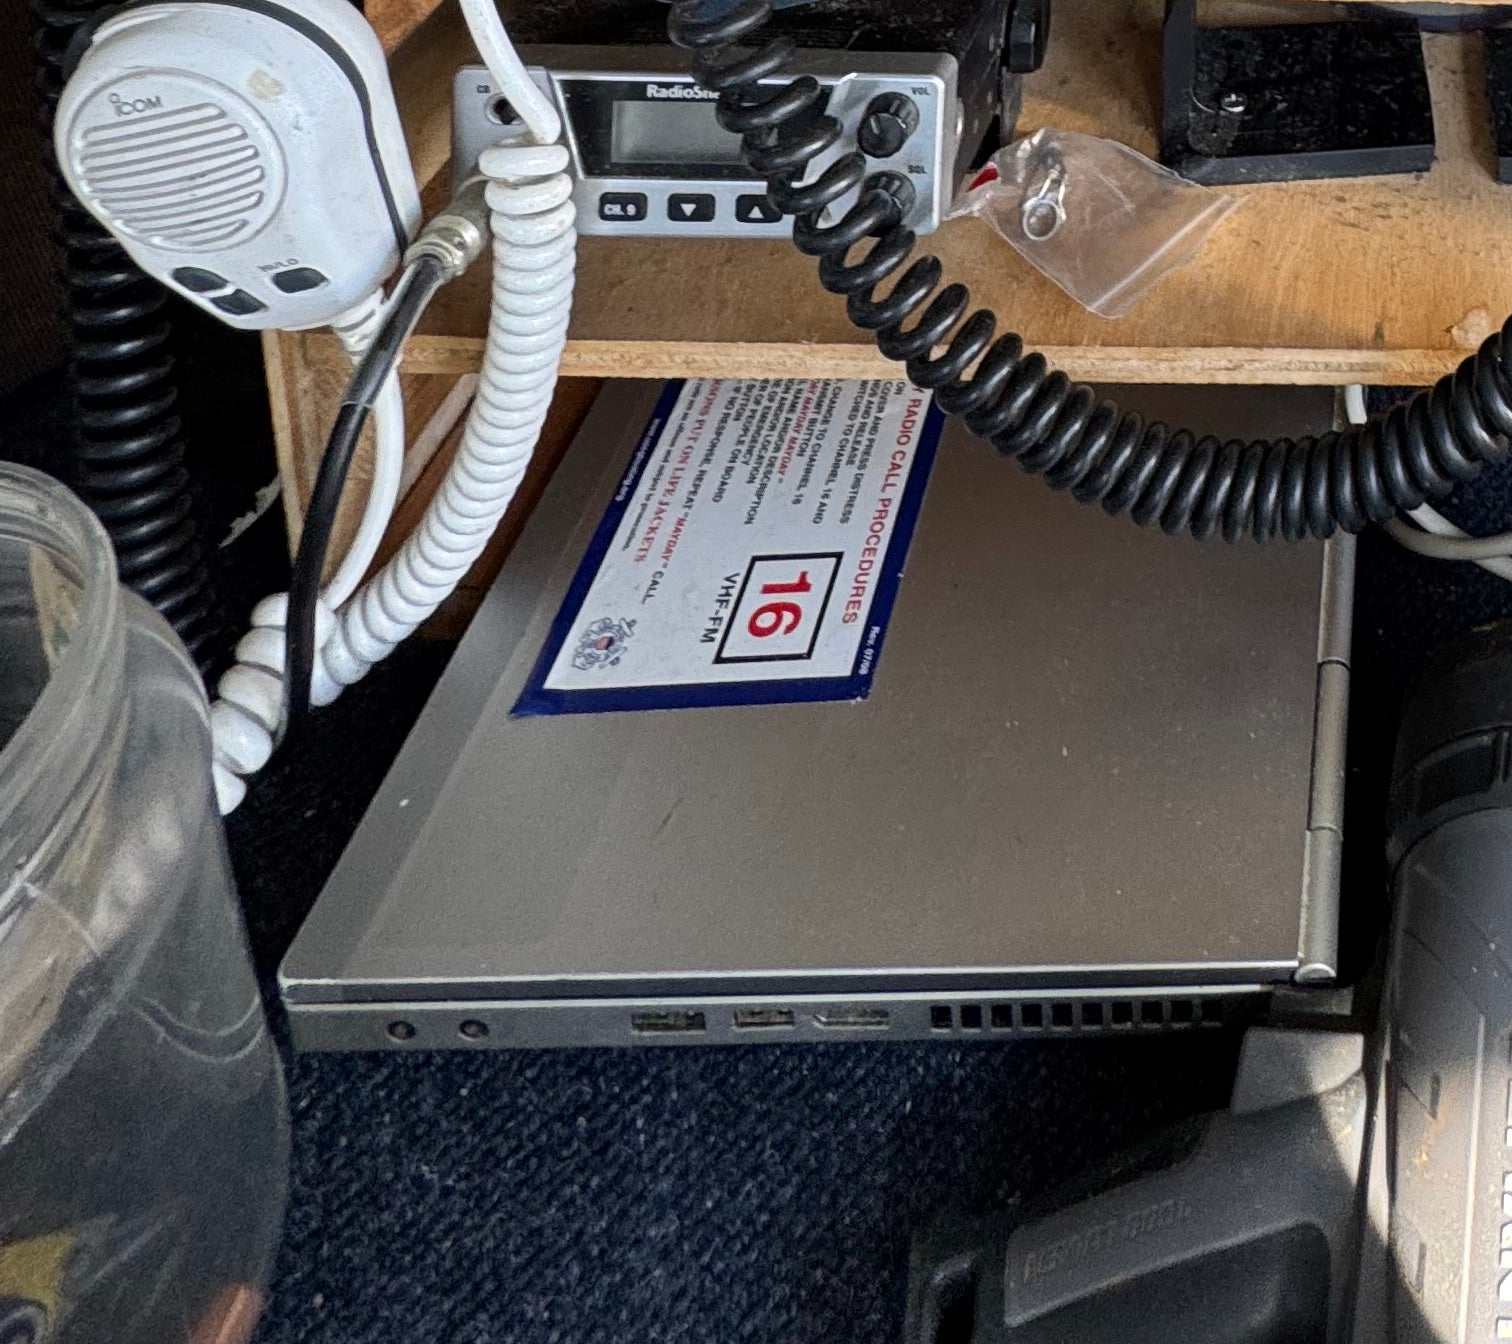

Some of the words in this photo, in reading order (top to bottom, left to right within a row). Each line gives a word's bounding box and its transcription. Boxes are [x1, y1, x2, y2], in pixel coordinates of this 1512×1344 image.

[723, 396, 738, 409] NO
[731, 384, 756, 421] BUTTON
[785, 388, 804, 413] NAME
[791, 397, 813, 433] MAYDAY
[818, 386, 842, 425] CHANGE
[859, 399, 874, 419] AND
[685, 419, 706, 442] PUT
[733, 408, 758, 445] PEOPLE
[739, 405, 772, 465] EMERGENCY
[794, 417, 818, 457] BUTTON
[813, 428, 827, 440] TO
[841, 423, 854, 435] TO
[867, 416, 882, 435] AND
[894, 399, 922, 445] RADIO
[676, 445, 695, 464] ON
[726, 448, 742, 463] ON
[745, 434, 773, 483] LOCATION
[824, 438, 849, 484] CHANNEL
[844, 421, 868, 465] RELEASE
[856, 438, 876, 470] PRESS
[661, 467, 685, 496] LIFE
[710, 465, 735, 502] BOARD
[795, 443, 822, 490] CHANNEL
[879, 450, 907, 492] CALL
[680, 470, 707, 509] REPEAT
[742, 455, 779, 524] DESCRIPTION
[820, 488, 832, 498] 16
[838, 473, 865, 524] DISTRESS
[632, 500, 671, 562] JACKETS
[811, 501, 828, 524] AND
[840, 497, 893, 624] PROCEDURES
[698, 572, 740, 643] VHF-FM
[748, 571, 812, 638] 16
